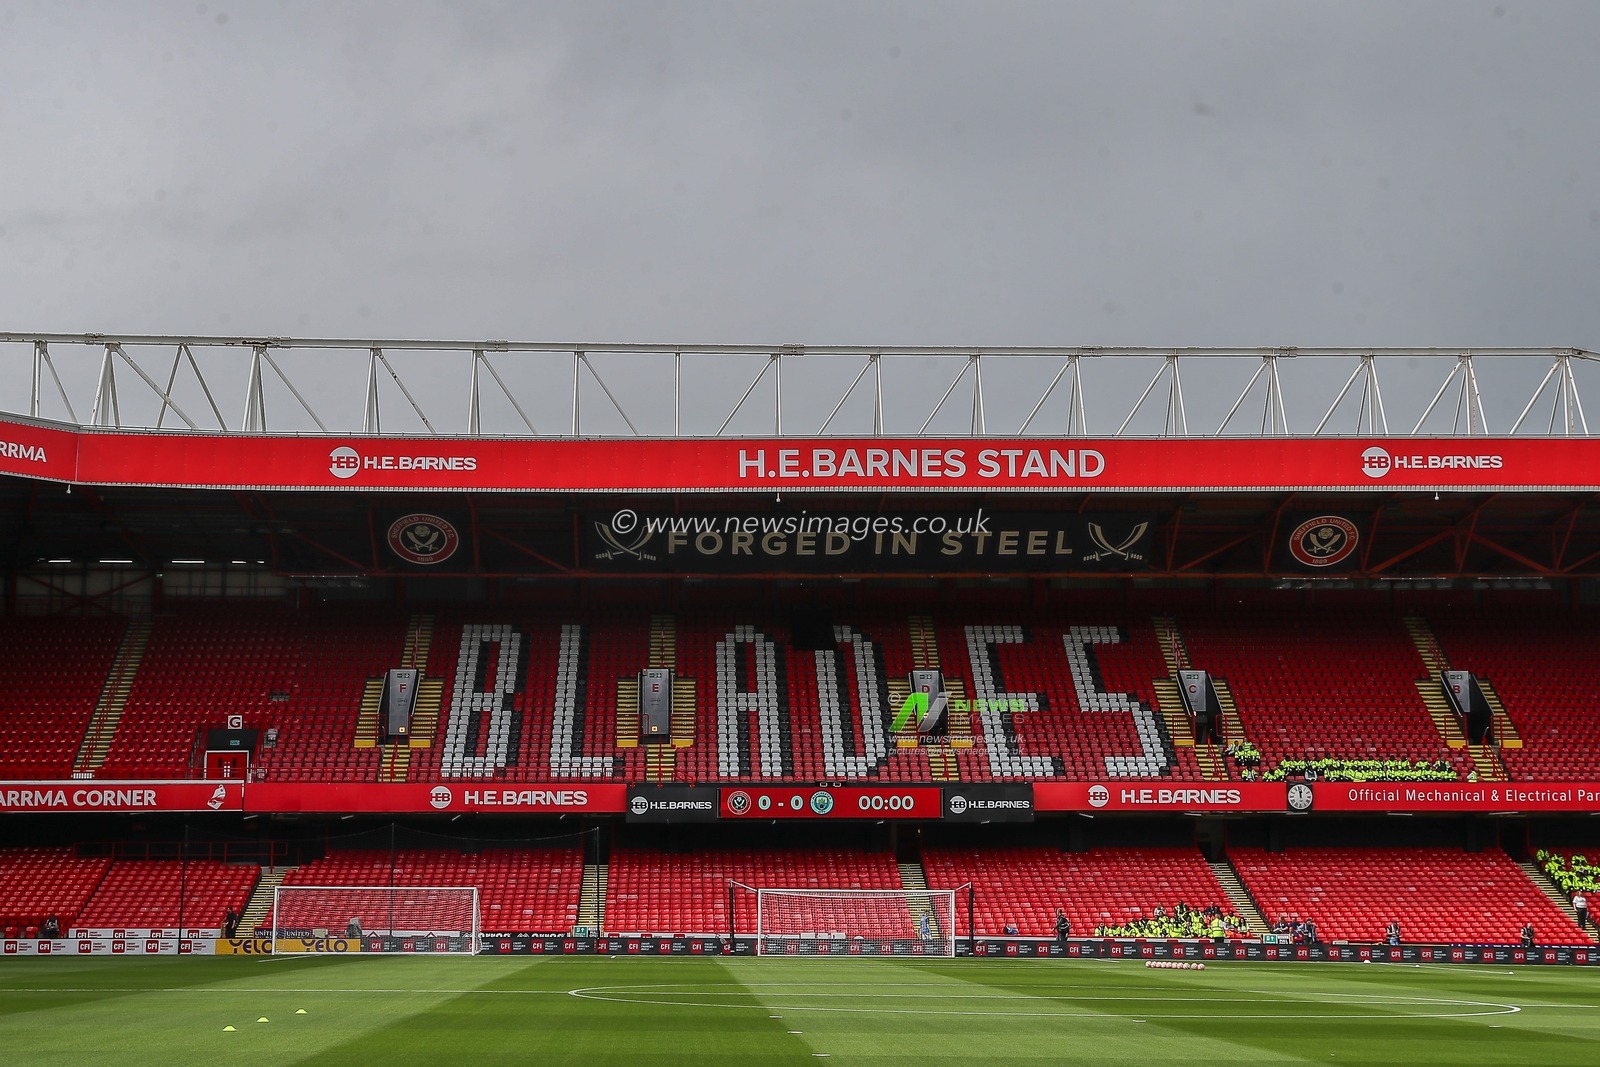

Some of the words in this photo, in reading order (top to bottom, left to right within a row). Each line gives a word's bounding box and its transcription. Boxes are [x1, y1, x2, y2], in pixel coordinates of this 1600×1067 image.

[364, 456, 477, 470] H.E.BARNES
[738, 448, 967, 479] H.E.BARNES
[976, 448, 1106, 478] STAND
[1394, 456, 1503, 469] H.E.BARNES
[422, 516, 447, 529] UNITED
[1294, 518, 1326, 540] SHEFFIELD
[1330, 519, 1352, 531] UNITED
[668, 531, 850, 555] FORGED
[874, 532, 917, 555] IN
[940, 531, 1072, 555] STEEL
[400, 684, 407, 693] F
[652, 684, 659, 692] E
[922, 685, 930, 693] D
[1189, 685, 1196, 693] C
[1453, 685, 1460, 693] B
[230, 717, 241, 728] G
[73, 790, 156, 806] CORNER
[464, 790, 588, 805] H.E.BARNES
[1121, 789, 1241, 804] H.E.BARNES
[1348, 789, 1400, 801] Official
[1406, 789, 1484, 801] Mechanical
[1491, 789, 1500, 801] &
[1505, 789, 1572, 801] Electrical
[1577, 789, 1600, 801] Par
[650, 801, 712, 810] H.E.BARNES
[758, 795, 771, 810] 0
[790, 795, 804, 810] 0
[858, 795, 914, 810] 00:00
[968, 801, 1030, 809] H.E.BARNES
[229, 940, 272, 954] YELO
[301, 940, 348, 952] YELO
